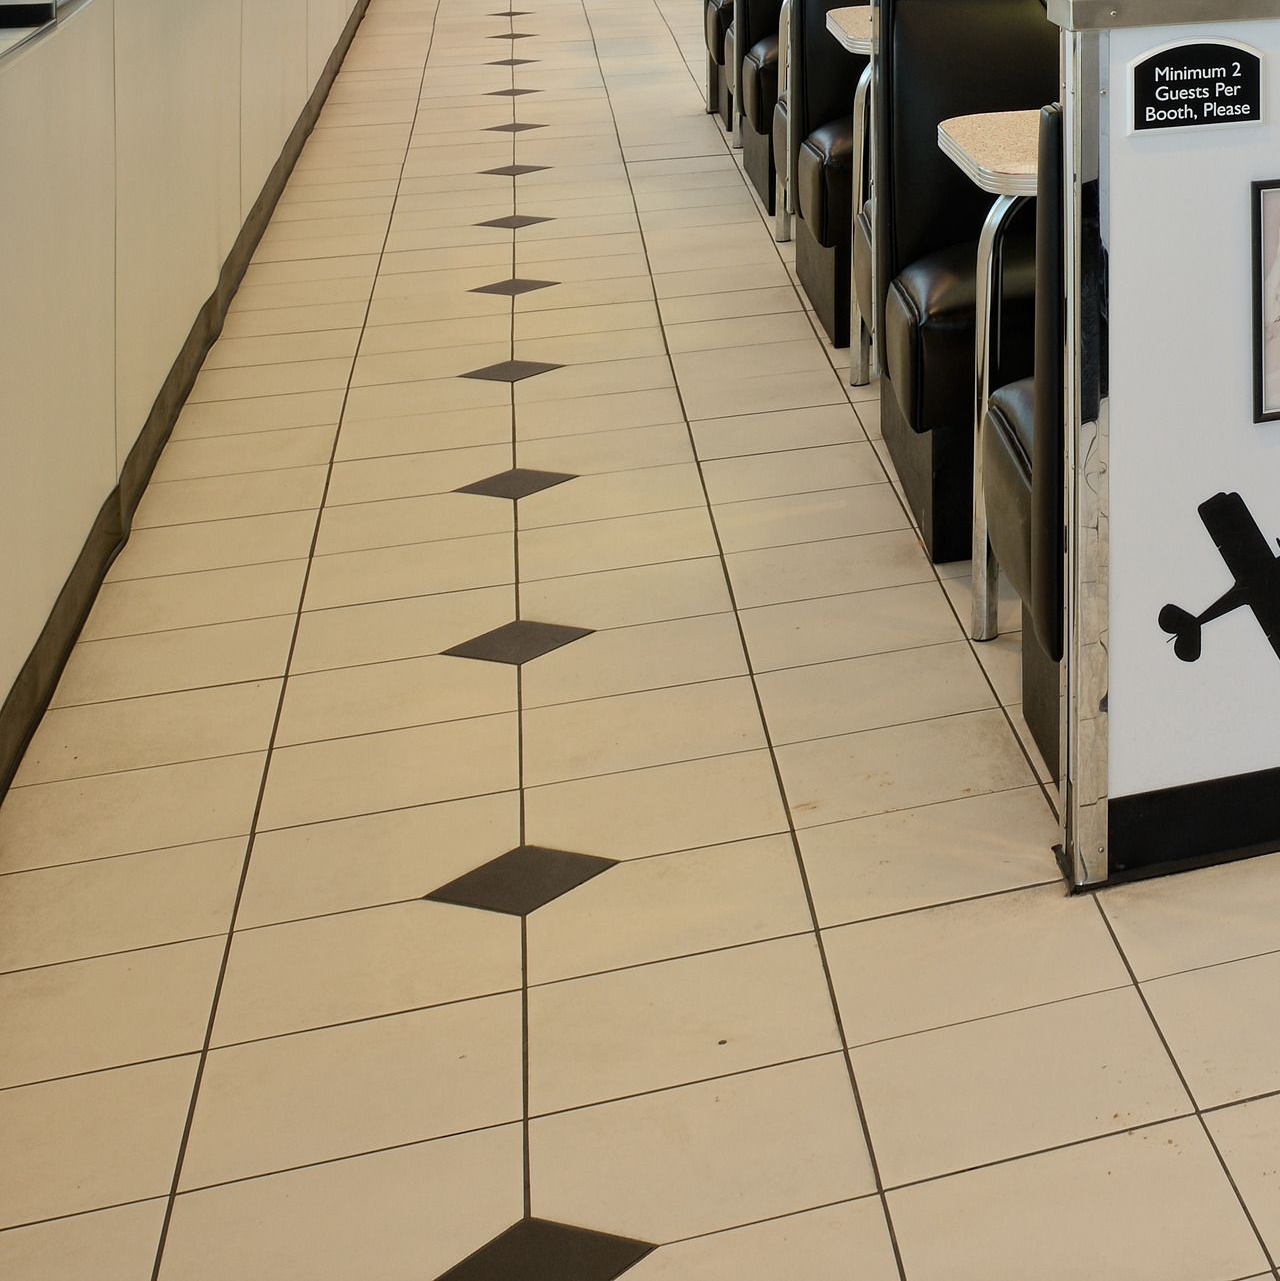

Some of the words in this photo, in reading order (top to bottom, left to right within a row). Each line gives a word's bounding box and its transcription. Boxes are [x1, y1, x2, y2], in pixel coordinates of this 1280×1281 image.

[1154, 66, 1227, 83] Minimum
[1231, 62, 1242, 77] 2
[1155, 86, 1210, 102] Guests
[1215, 83, 1242, 98] Per
[1145, 104, 1198, 122] Booth,
[1203, 101, 1251, 118] Please
